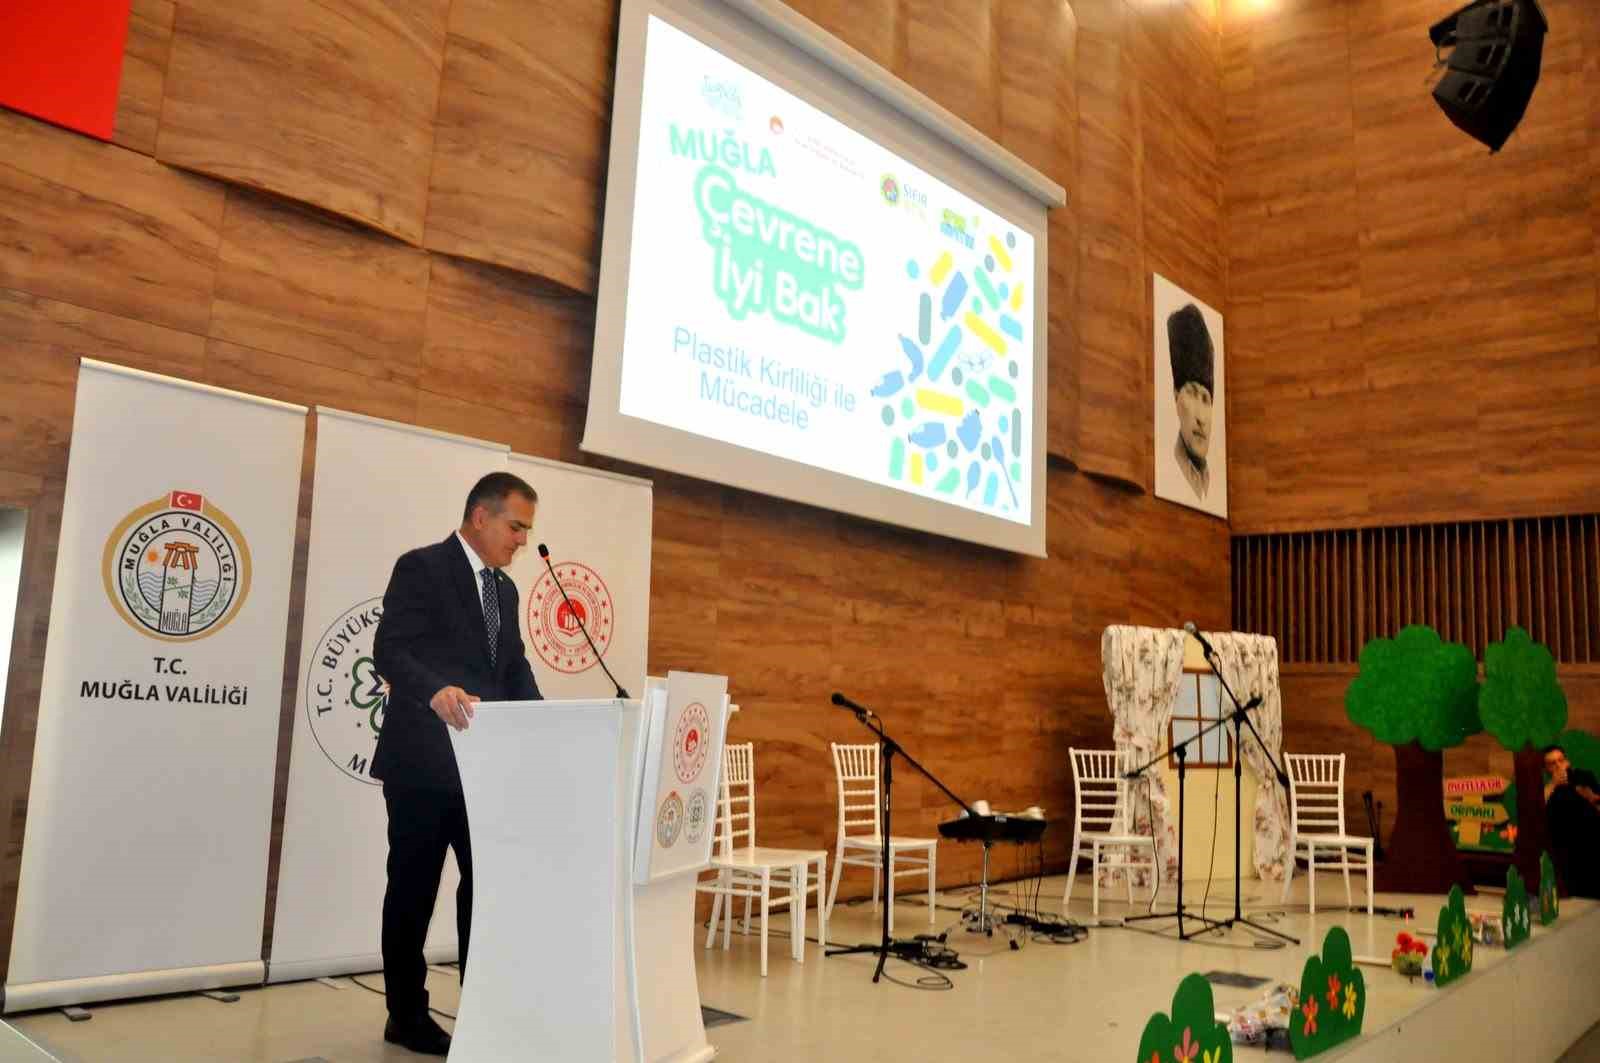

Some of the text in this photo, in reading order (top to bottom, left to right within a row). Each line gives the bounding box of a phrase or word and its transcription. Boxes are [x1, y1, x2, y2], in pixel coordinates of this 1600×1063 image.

[669, 122, 777, 178] MUĞLA
[700, 173, 863, 285] Çevrene
[720, 233, 845, 334] İyi Bak
[674, 325, 856, 412] Plastik Kirliliği ile
[700, 371, 809, 430] Mücadele
[124, 517, 234, 582] MUĞLA VALİLİĞİ
[162, 609, 188, 632] MUĞLA
[80, 680, 248, 706] MUĞLA VALİLİĞİ
[153, 656, 187, 675] T.C.
[317, 678, 334, 718] T.C.
